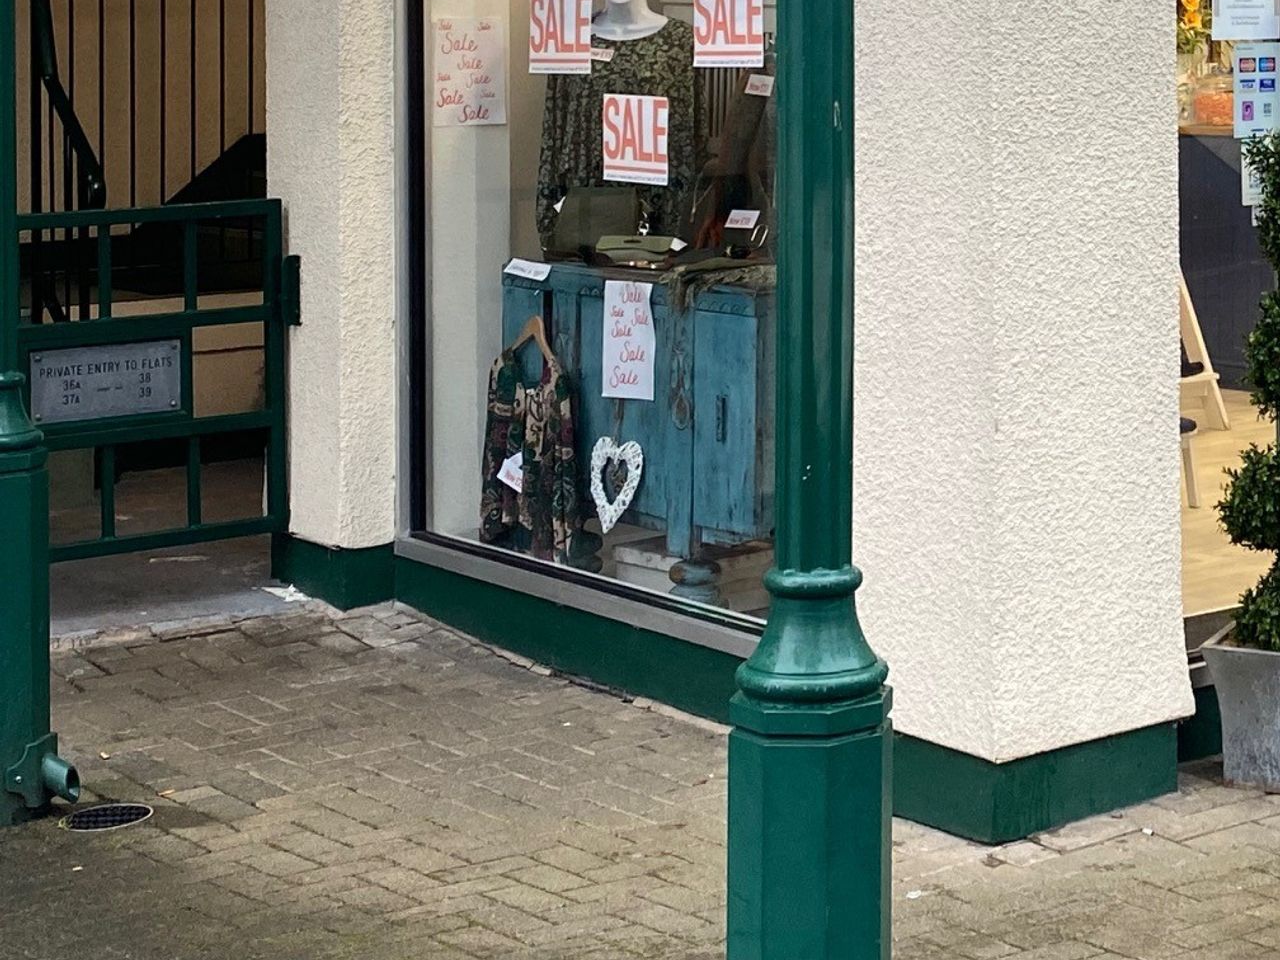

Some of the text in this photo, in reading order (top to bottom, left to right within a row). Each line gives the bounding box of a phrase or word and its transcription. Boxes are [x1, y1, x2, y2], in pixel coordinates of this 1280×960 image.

[441, 32, 478, 54] Sale
[457, 54, 483, 71] Sale
[466, 73, 491, 89] Sale
[436, 88, 464, 108] Sale
[459, 104, 490, 123] Sale
[603, 97, 668, 163] SALE
[622, 283, 642, 303] Sale
[631, 308, 649, 326] Sale
[611, 320, 633, 338] Sale
[620, 341, 645, 364] Sale
[39, 356, 173, 379] PRIVATE ENTRY TO FLATS
[138, 372, 152, 383] 38
[609, 365, 639, 389] Sale
